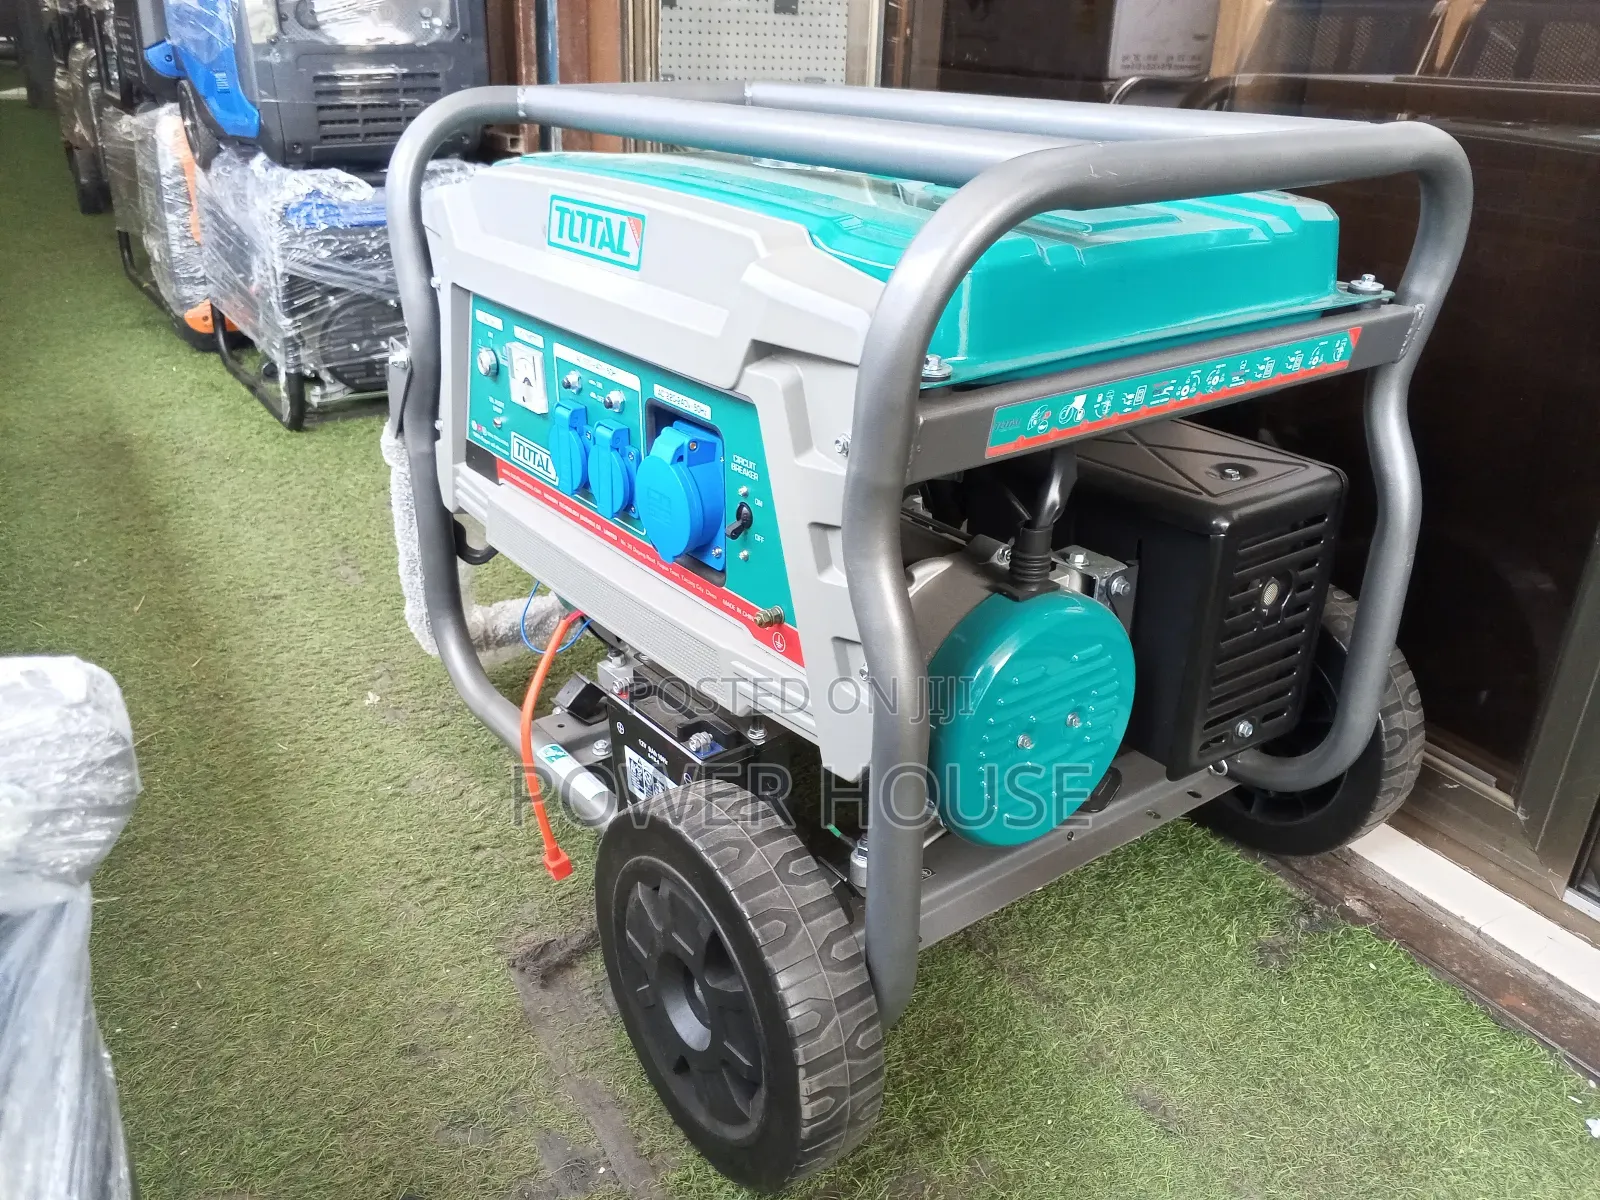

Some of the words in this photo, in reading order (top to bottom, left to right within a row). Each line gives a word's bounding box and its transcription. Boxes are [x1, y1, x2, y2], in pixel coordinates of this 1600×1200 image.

[555, 205, 631, 258] TOTAL
[515, 440, 552, 476] TOTAL
[733, 454, 756, 471] CIRCUIT
[731, 463, 759, 481] BREAKER
[754, 498, 763, 507] ON
[754, 533, 765, 543] OFF
